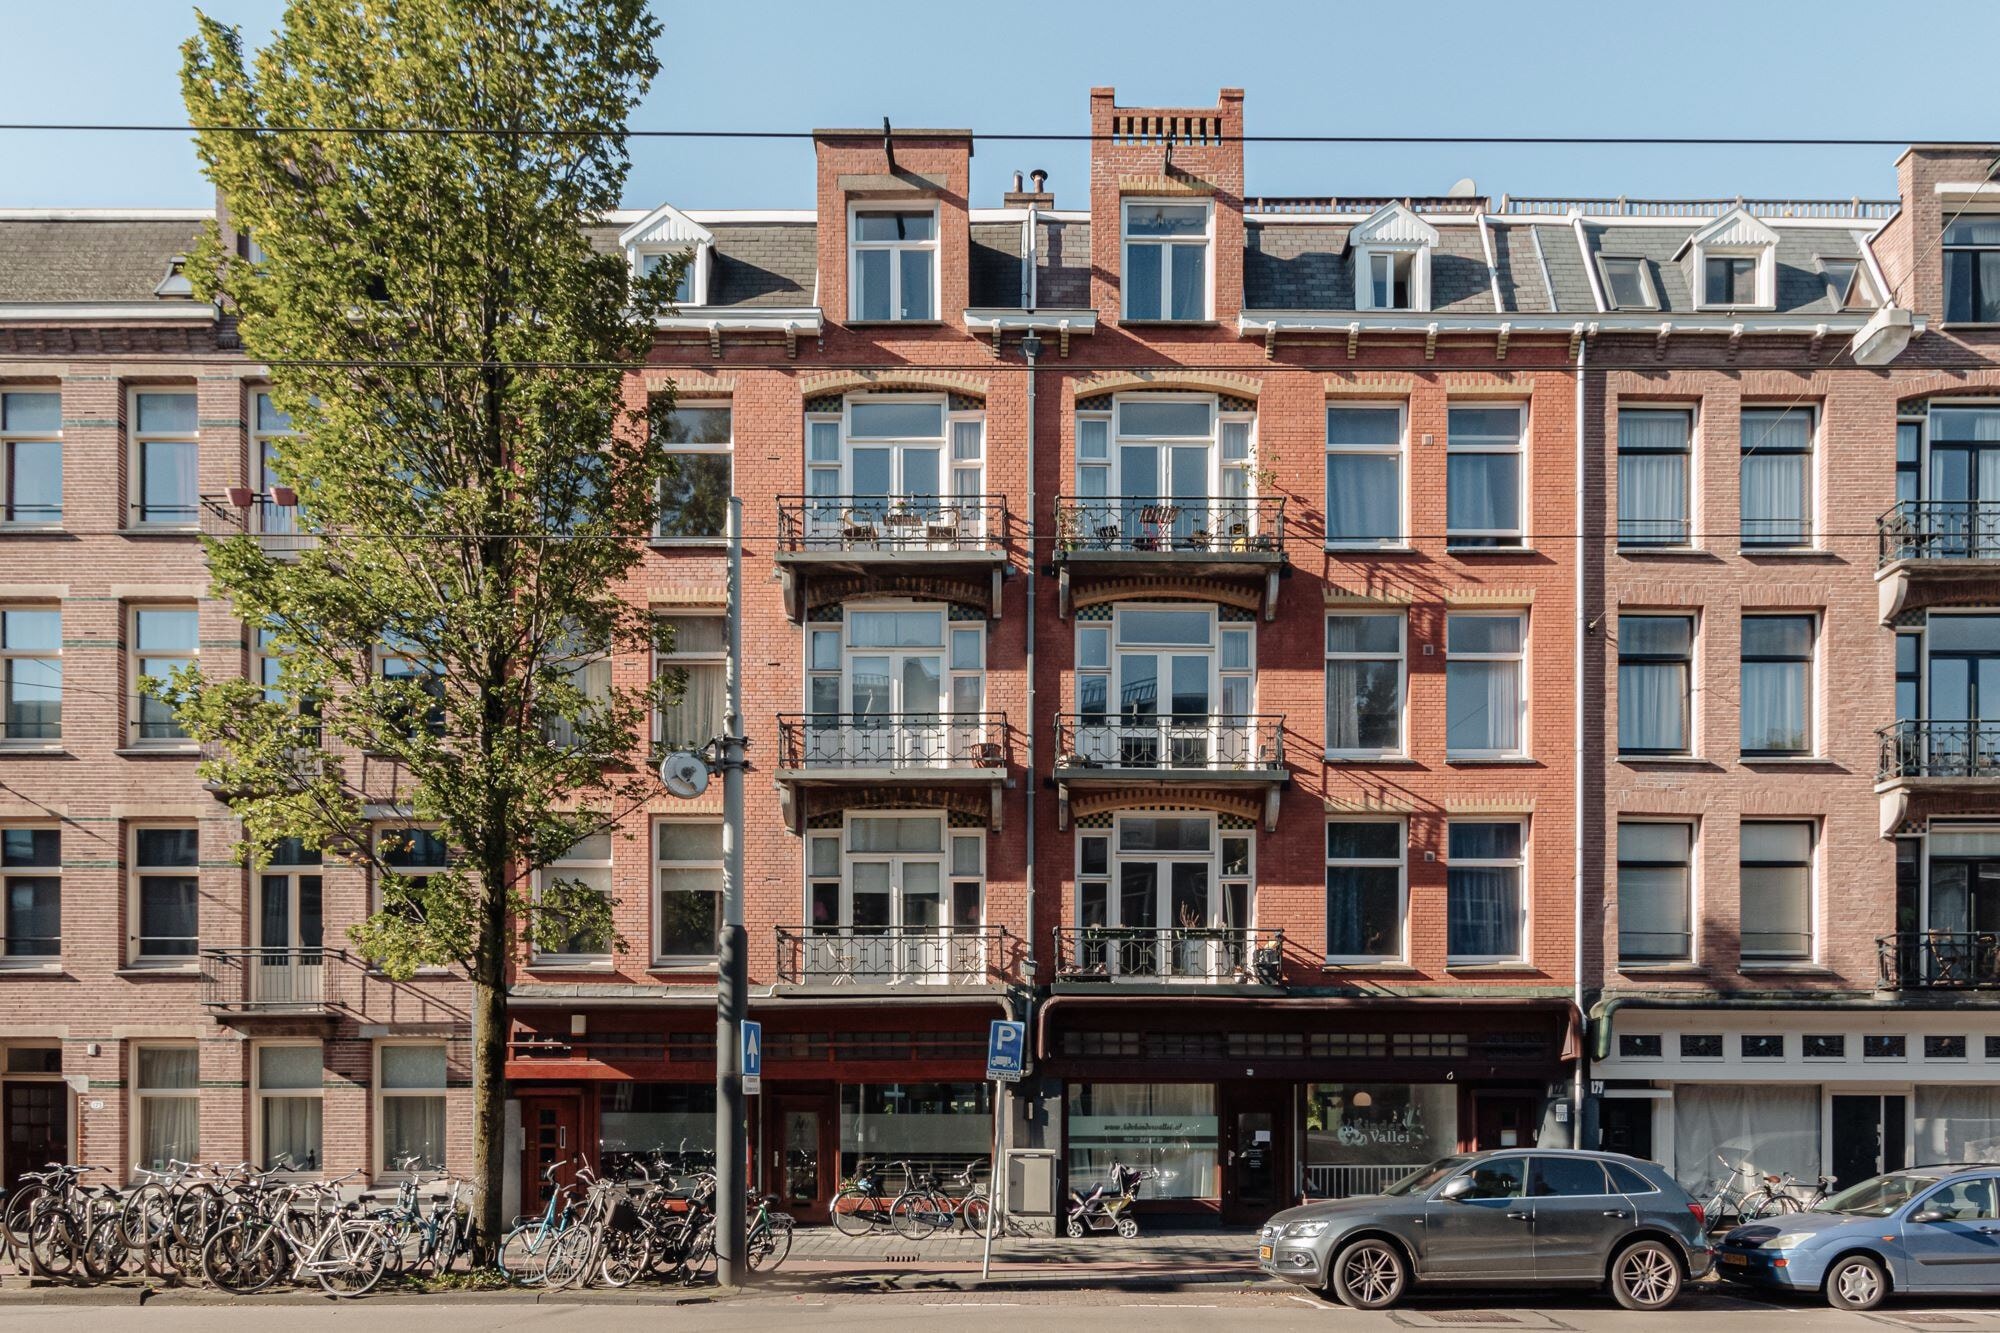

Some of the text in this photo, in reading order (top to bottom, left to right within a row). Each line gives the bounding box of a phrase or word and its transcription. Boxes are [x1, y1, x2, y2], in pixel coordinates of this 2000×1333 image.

[997, 1025, 1016, 1050] P
[1591, 1080, 1604, 1094] 179
[1353, 1119, 1402, 1131] Kinder
[1369, 1129, 1410, 1143] Vallei
